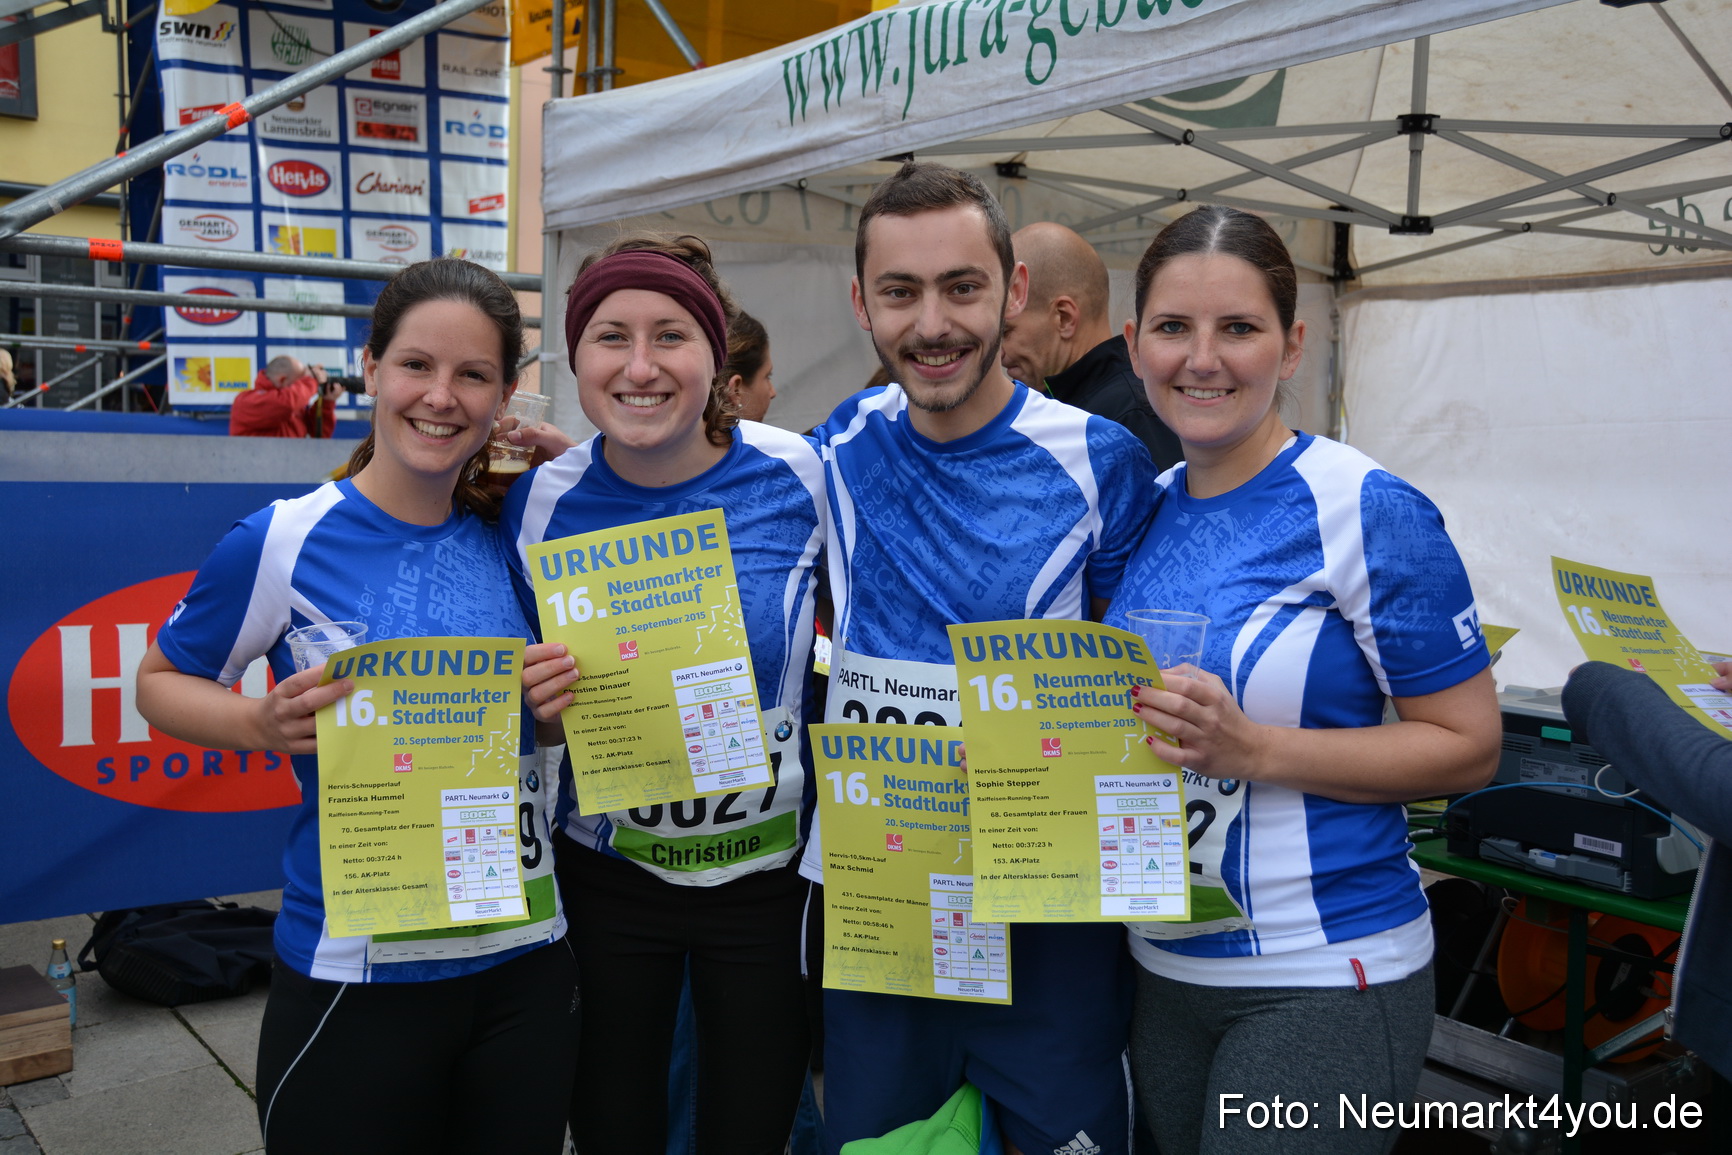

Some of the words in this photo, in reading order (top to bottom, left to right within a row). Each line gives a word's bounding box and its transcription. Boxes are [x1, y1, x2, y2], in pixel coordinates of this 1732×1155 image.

[159, 21, 211, 40] swn
[271, 115, 323, 126] Neumarkter
[263, 122, 332, 139] Lammsbräu
[272, 166, 326, 190] Hervis
[179, 219, 226, 229] GERHART
[540, 523, 720, 581] URKUNDE
[607, 564, 723, 597] Neumarkter
[1557, 569, 1656, 607] URKUNDE
[546, 586, 608, 627] 16.
[610, 584, 703, 616] Stadtlauf
[615, 626, 631, 635] 20.
[631, 617, 683, 634] September
[684, 611, 706, 623] 2015
[1568, 605, 1611, 636] 16.
[1601, 610, 1668, 628] Neumarkter
[1609, 625, 1666, 643] Stadtlauf
[621, 652, 638, 660] DKMS
[962, 632, 1148, 664] URKUNDE
[332, 650, 514, 680] URKUNDE
[676, 673, 699, 681] PARTL
[700, 666, 732, 676] Neumarkt
[600, 682, 631, 691] Dinauer
[837, 668, 880, 693] PARTL
[1033, 671, 1153, 689] Neumarkter
[393, 688, 511, 705] Neumarkter
[694, 682, 732, 697] BOCK
[968, 674, 1032, 712] 16.
[1036, 689, 1133, 710] Stadtlauf
[335, 690, 388, 727] 16.
[393, 707, 487, 726] Stadtlauf
[593, 710, 632, 719] Gesamtplatz
[646, 703, 670, 711] Frauen
[1039, 721, 1055, 730] 20.
[1056, 720, 1111, 731] September
[1113, 719, 1136, 727] 2015
[393, 737, 408, 745] 20.
[409, 735, 461, 747] September
[463, 735, 484, 743] 2015
[606, 750, 633, 758] AK-Platz
[96, 749, 282, 785] SPORTS
[602, 763, 644, 773] Altersklasse:
[646, 759, 671, 767] Gesamt
[975, 766, 1049, 774] Hervis-Schnupperlauf
[328, 781, 401, 790] Hervis-Schnupperlauf
[825, 771, 880, 806] 16.
[976, 780, 1004, 788] Sophie
[328, 795, 368, 803] Franziska
[883, 793, 970, 816] Stadtlauf
[1117, 798, 1158, 807] BOCK
[460, 810, 496, 820] BOCK
[354, 825, 397, 833] Gesamtplatz
[885, 818, 898, 827] 20.
[900, 820, 947, 833] September
[949, 824, 970, 833] 2015
[651, 834, 761, 866] Christine
[829, 852, 886, 862] Hervis-10,5km-Lauf
[847, 865, 874, 873] Schmid
[355, 886, 400, 894] Altersklasse:
[856, 893, 893, 902] Gesamtplatz
[851, 947, 891, 955] Altersklasse:
